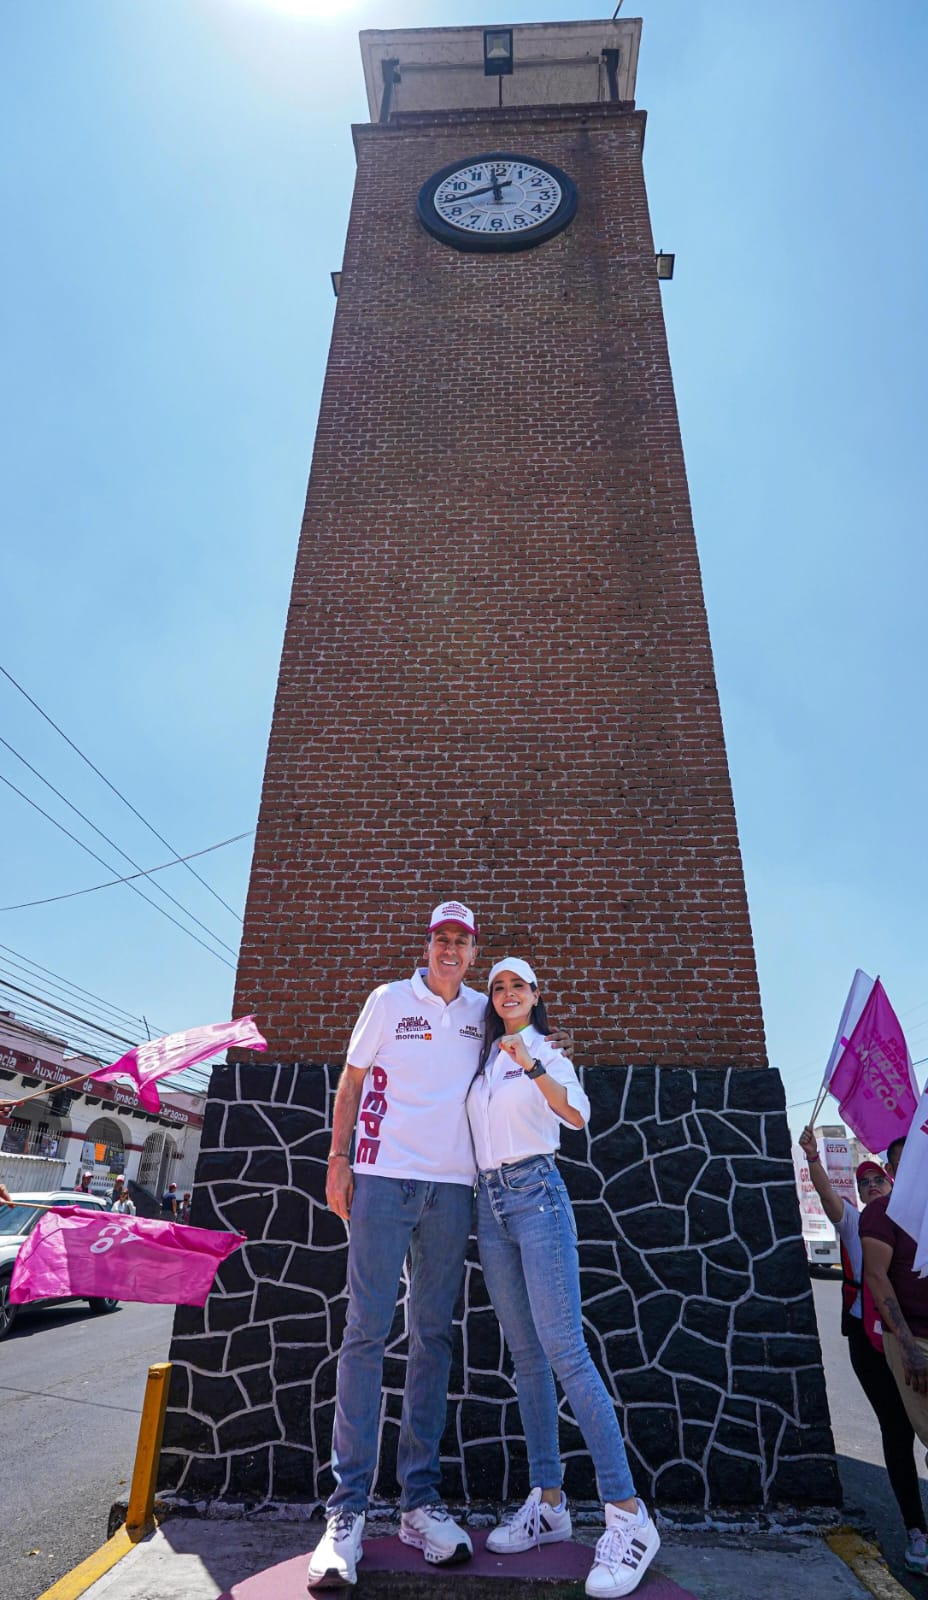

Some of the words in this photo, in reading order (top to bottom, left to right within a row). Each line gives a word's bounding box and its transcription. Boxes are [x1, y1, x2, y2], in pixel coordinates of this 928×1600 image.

[471, 171, 482, 181] 11
[517, 170, 524, 180] 1
[452, 182, 467, 191] 10
[531, 178, 542, 187] 2
[539, 191, 550, 200] 3
[452, 207, 462, 216] 8
[531, 204, 542, 214] 4
[470, 215, 481, 224] 7
[491, 218, 502, 228] 6
[513, 214, 526, 224] 5
[398, 1019, 429, 1028] PUEBLA
[82, 1078, 92, 1092] de
[356, 1066, 388, 1164] PEPE
